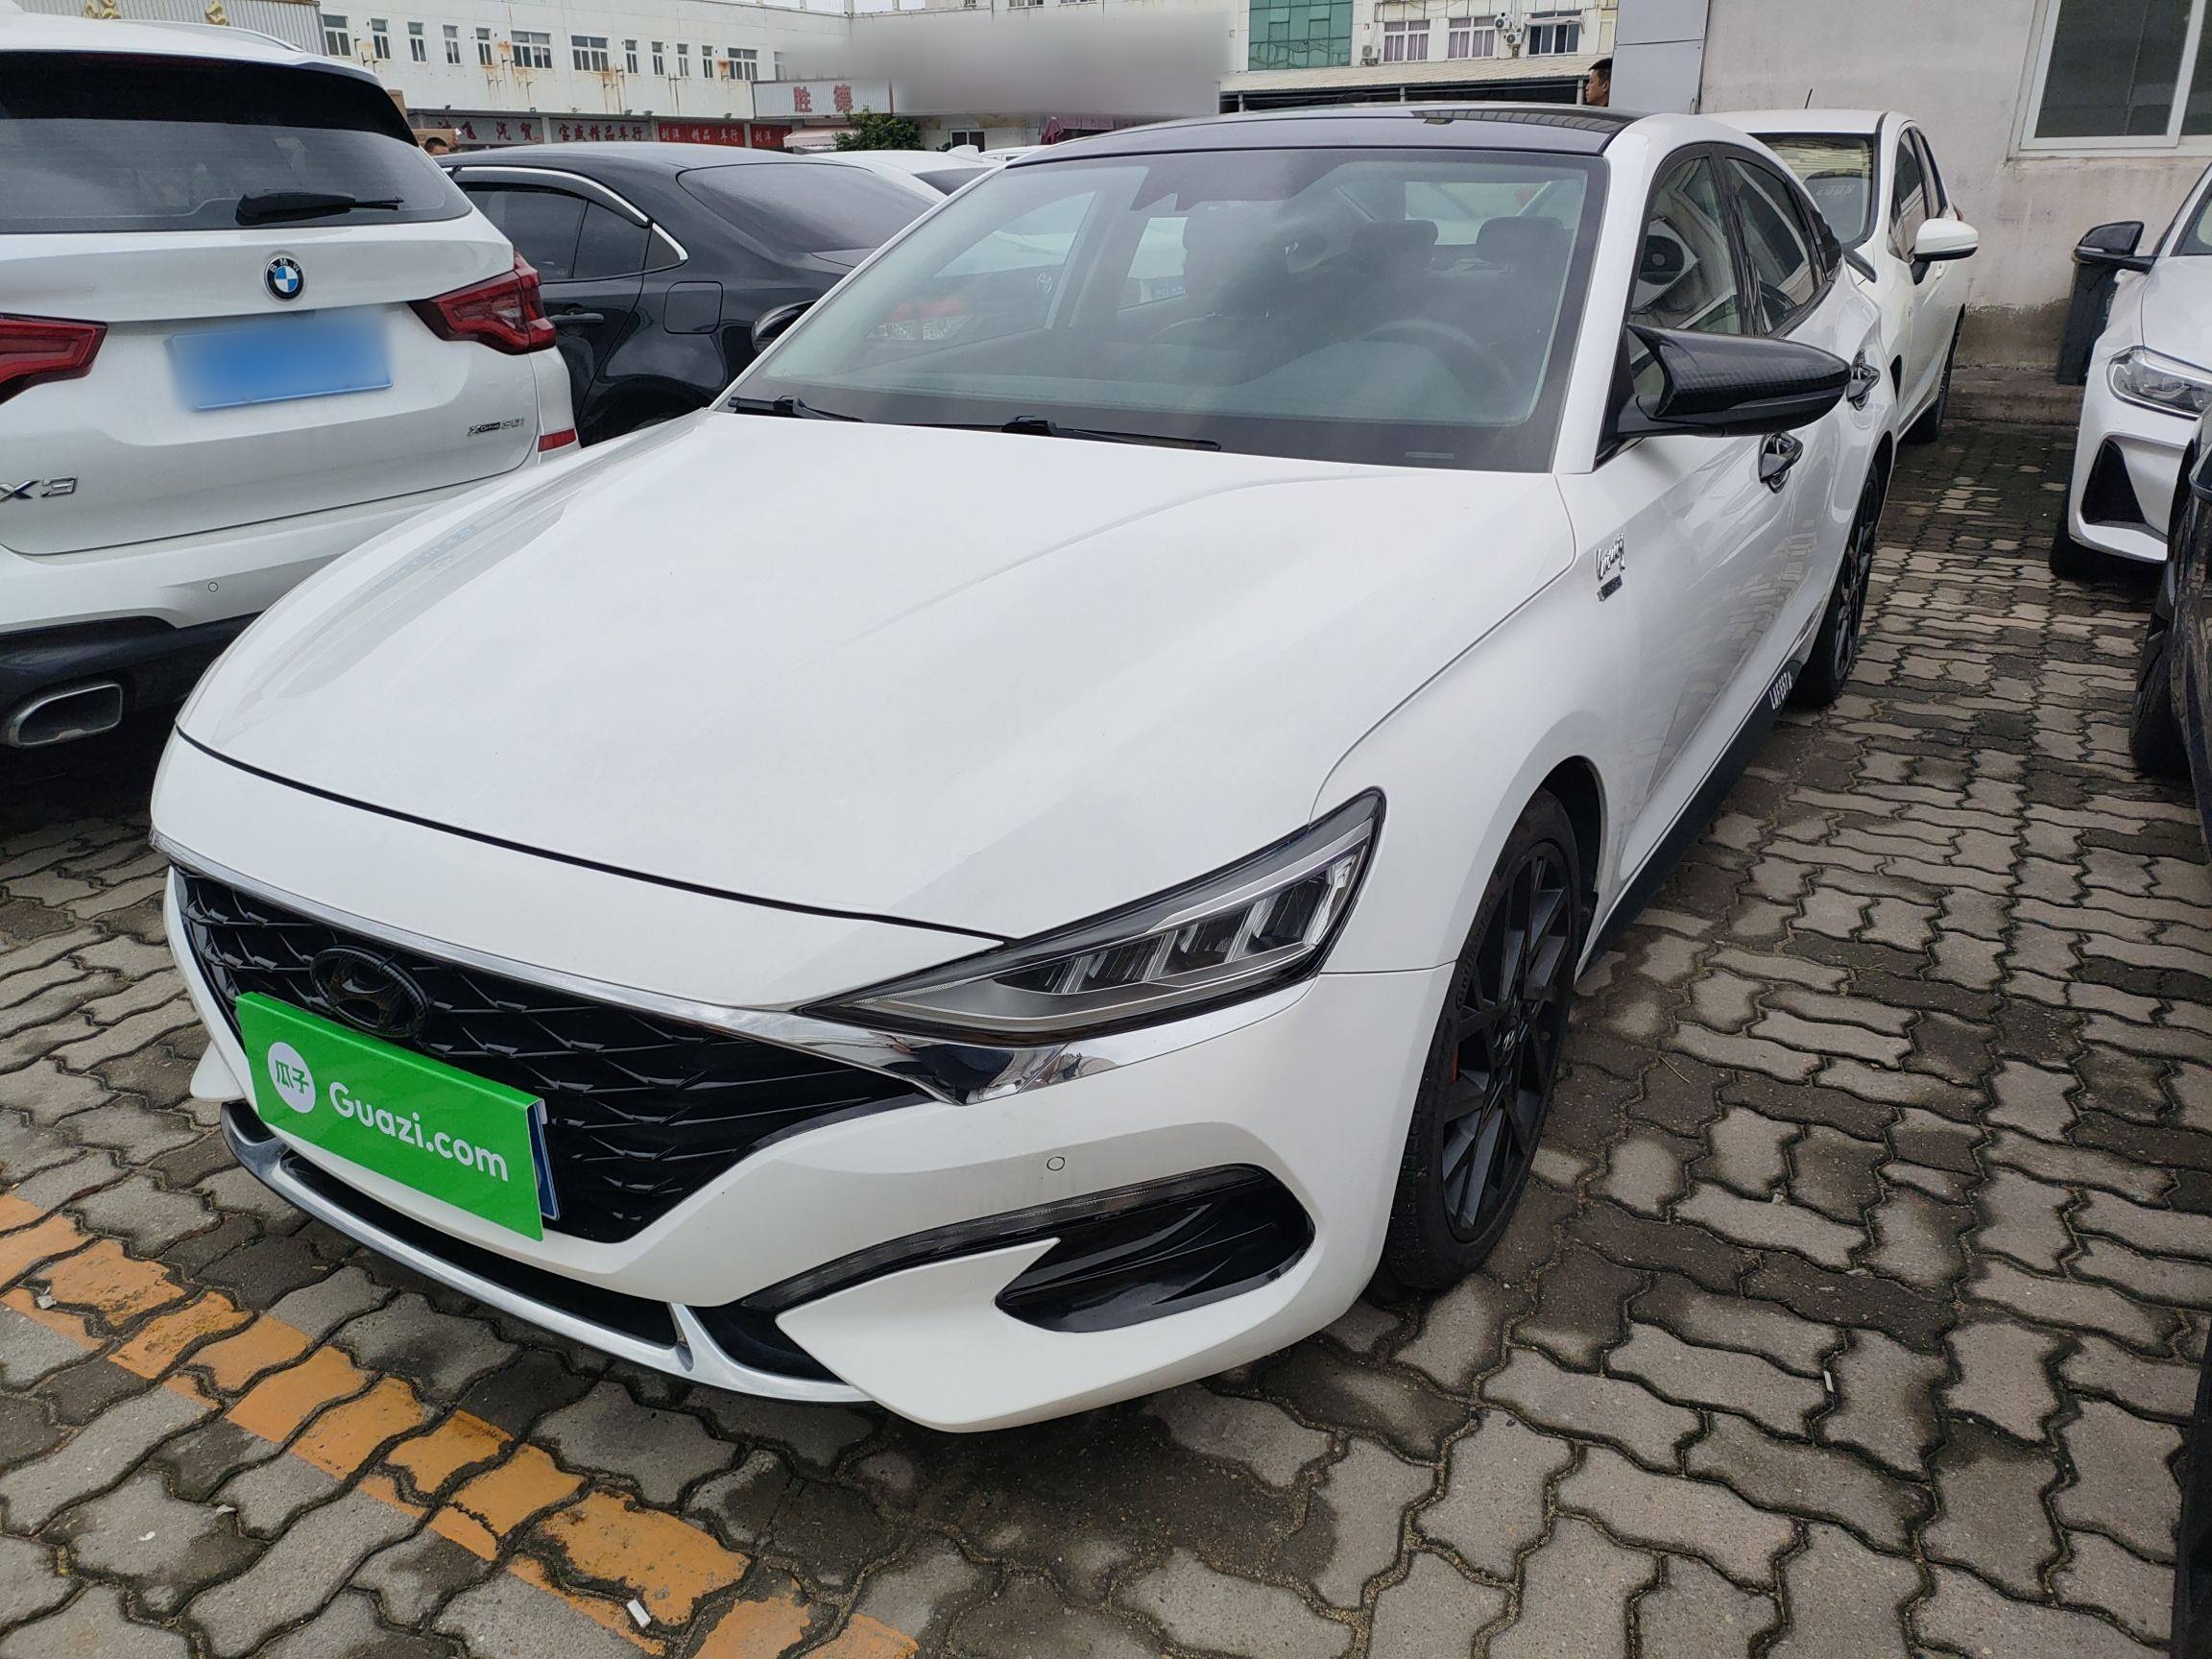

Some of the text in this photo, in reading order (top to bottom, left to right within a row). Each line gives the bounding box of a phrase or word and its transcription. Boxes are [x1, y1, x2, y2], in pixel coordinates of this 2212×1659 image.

[0, 475, 77, 503] X3
[275, 1059, 309, 1094] 瓜子
[328, 1081, 509, 1182] Guazi.com
